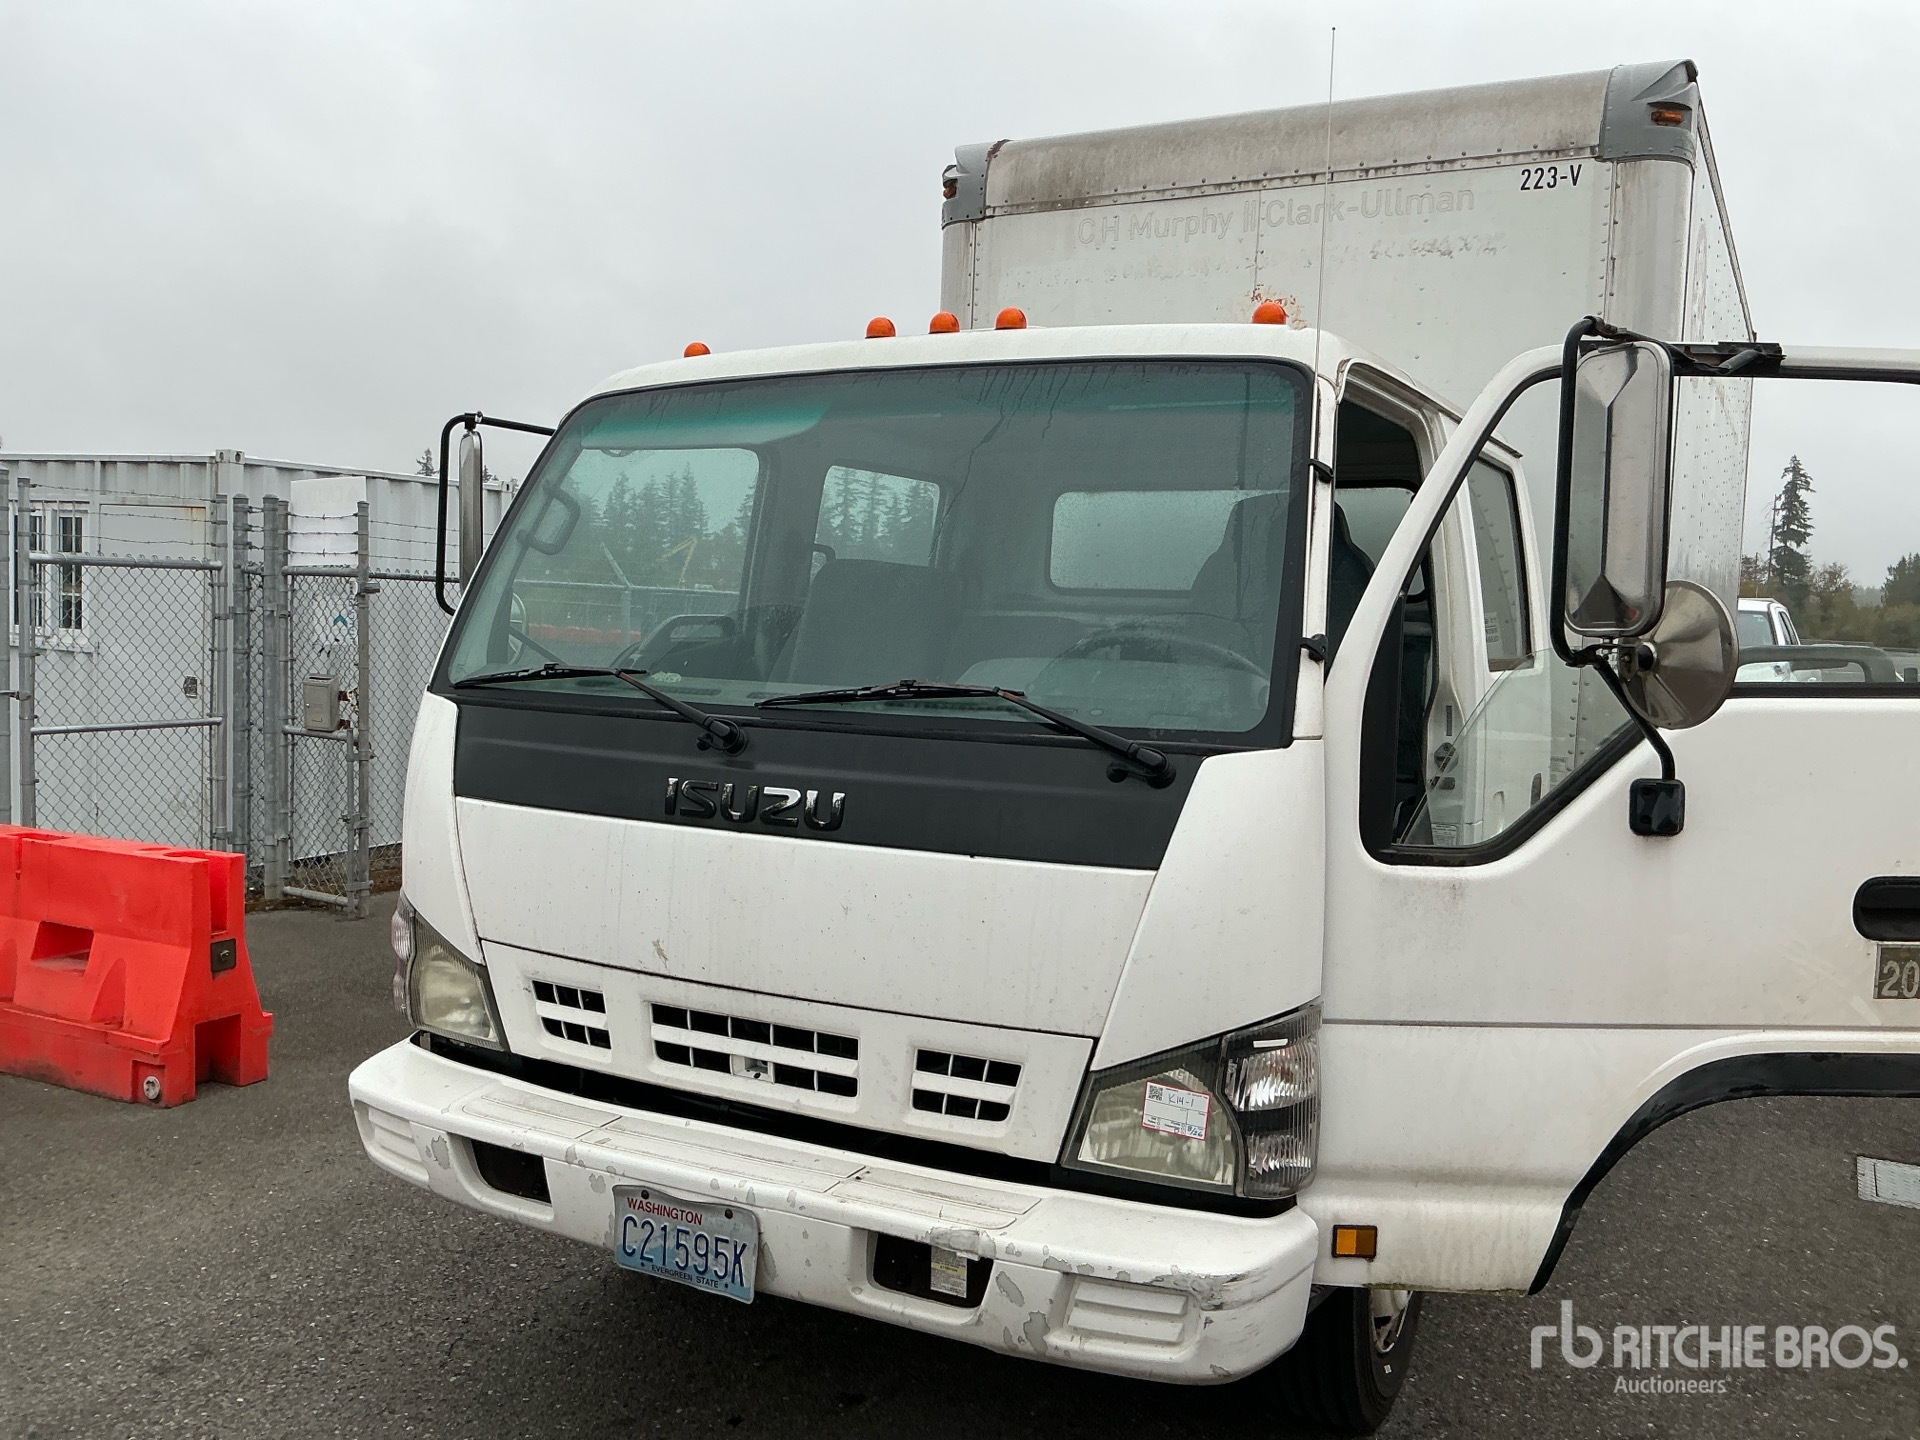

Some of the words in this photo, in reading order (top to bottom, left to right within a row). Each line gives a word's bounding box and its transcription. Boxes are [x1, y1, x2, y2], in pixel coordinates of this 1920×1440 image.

[1520, 164, 1582, 191] 223-V
[1129, 206, 1234, 243] Murphy
[1265, 188, 1476, 228] Clark-Ullman
[664, 777, 846, 832] ISUZU
[626, 1197, 703, 1226] WASHINGTON
[622, 1215, 747, 1288] C21595K
[651, 1264, 693, 1281] EVERGREEN
[695, 1275, 719, 1289] STATE
